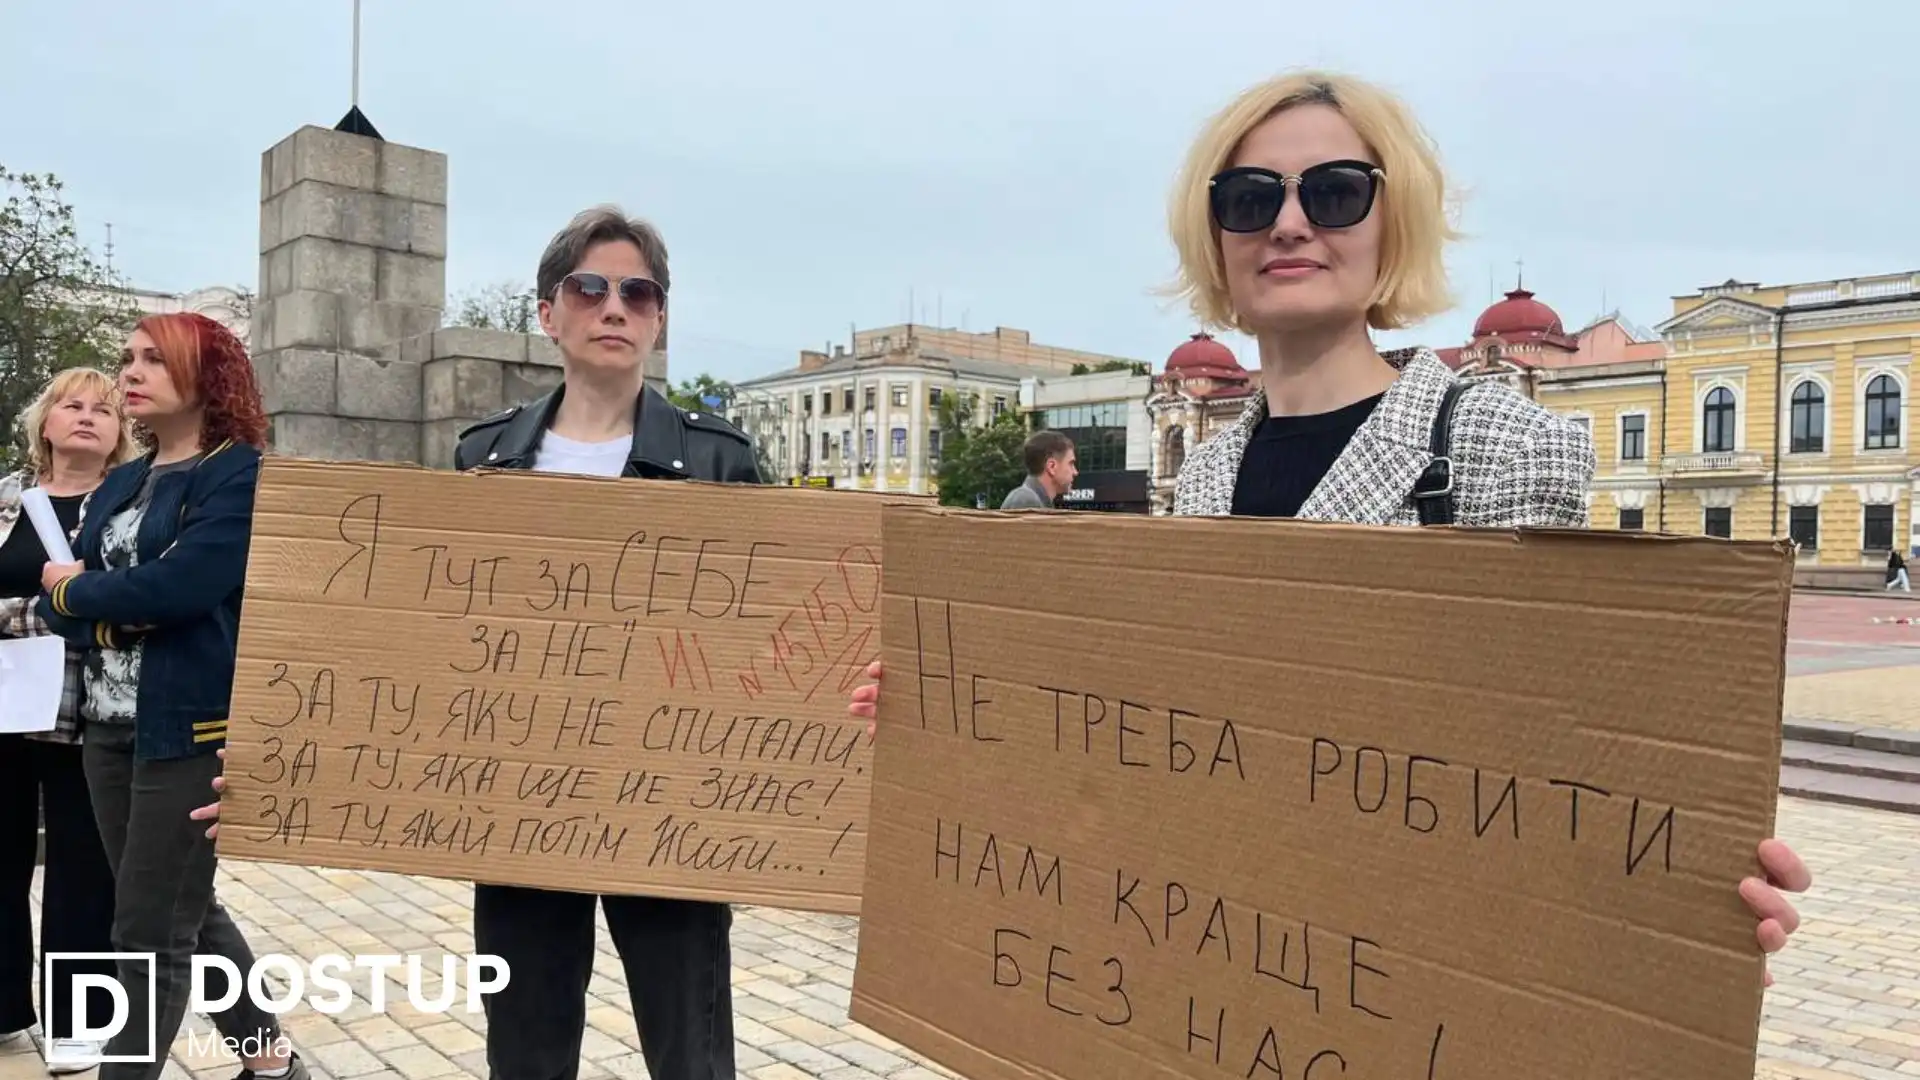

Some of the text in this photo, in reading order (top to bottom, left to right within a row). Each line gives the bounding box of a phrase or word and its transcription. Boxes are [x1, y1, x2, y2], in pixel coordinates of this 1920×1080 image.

[323, 493, 788, 619] Я ТУТ ЗА СЕБЕ
[449, 619, 637, 681] ЗА НЕЇ
[250, 663, 335, 728] ЗА
[359, 676, 421, 743] ТУ,
[437, 687, 539, 747] ЯКУ
[553, 697, 623, 750] НЕ
[248, 737, 318, 788] ЗА
[412, 752, 501, 796] ЯКА
[517, 763, 601, 808] ЩЕ
[616, 769, 674, 804] НЕ
[1037, 685, 1246, 781] ТРЕБА
[1310, 737, 1675, 876] РОБИТИ
[244, 795, 311, 846] ЗА
[400, 804, 496, 856] ЯКІЙ
[510, 812, 628, 863] ПОТІМ
[935, 818, 1393, 1020] НАМ КРАЩЕ
[993, 927, 1133, 1026] БЕЗ
